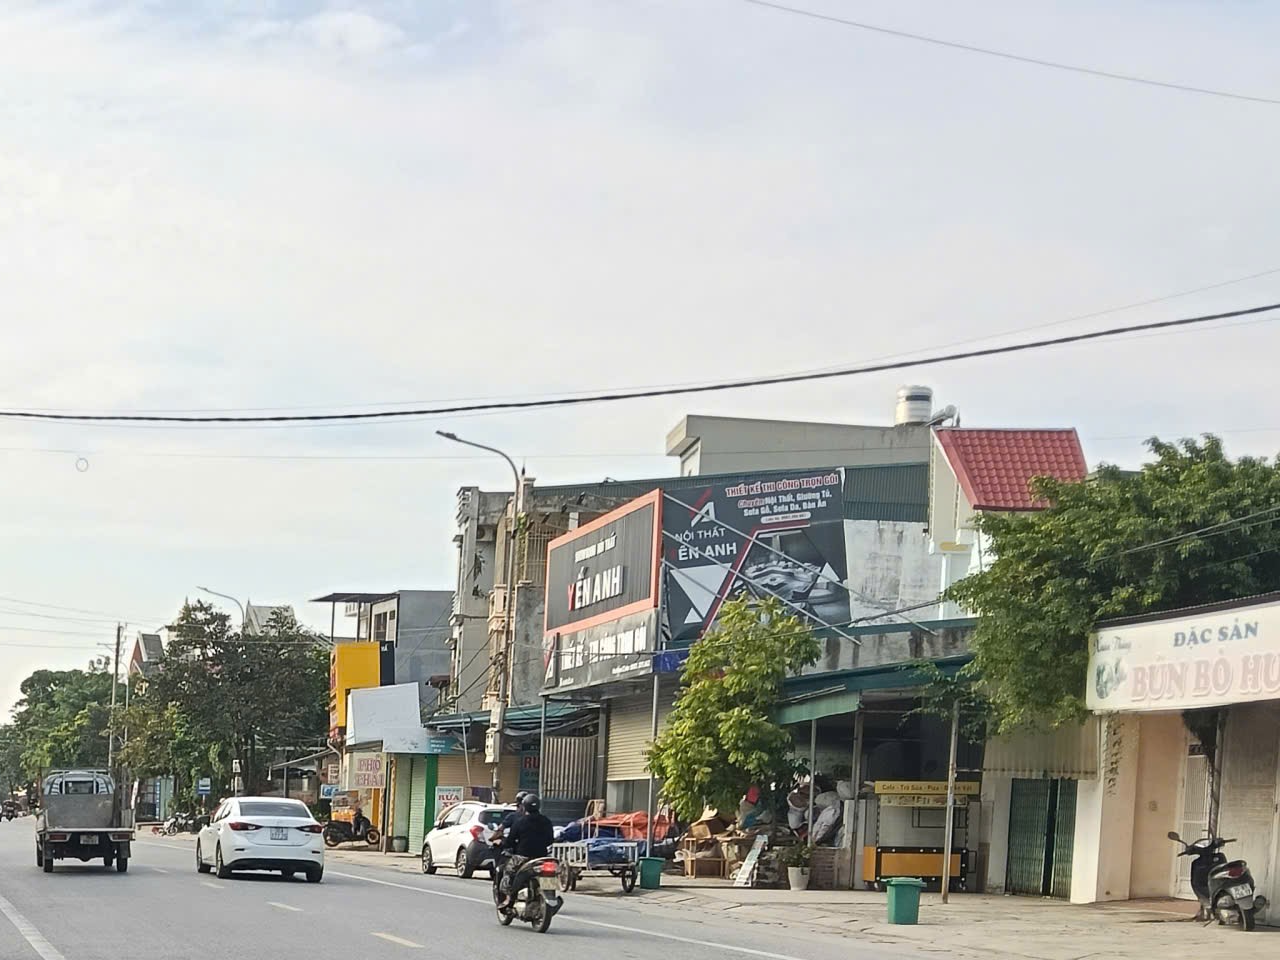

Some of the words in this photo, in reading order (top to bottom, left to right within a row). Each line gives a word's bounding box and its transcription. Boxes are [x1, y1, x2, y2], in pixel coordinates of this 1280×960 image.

[674, 530, 694, 543] NỘI
[697, 525, 726, 539] THẤT
[705, 542, 737, 558] ANH
[567, 565, 591, 612] YẾN
[592, 565, 623, 604] ANH
[1173, 626, 1213, 650] ĐẶC
[1217, 618, 1259, 642] SẢN
[1131, 655, 1189, 702] BÚN
